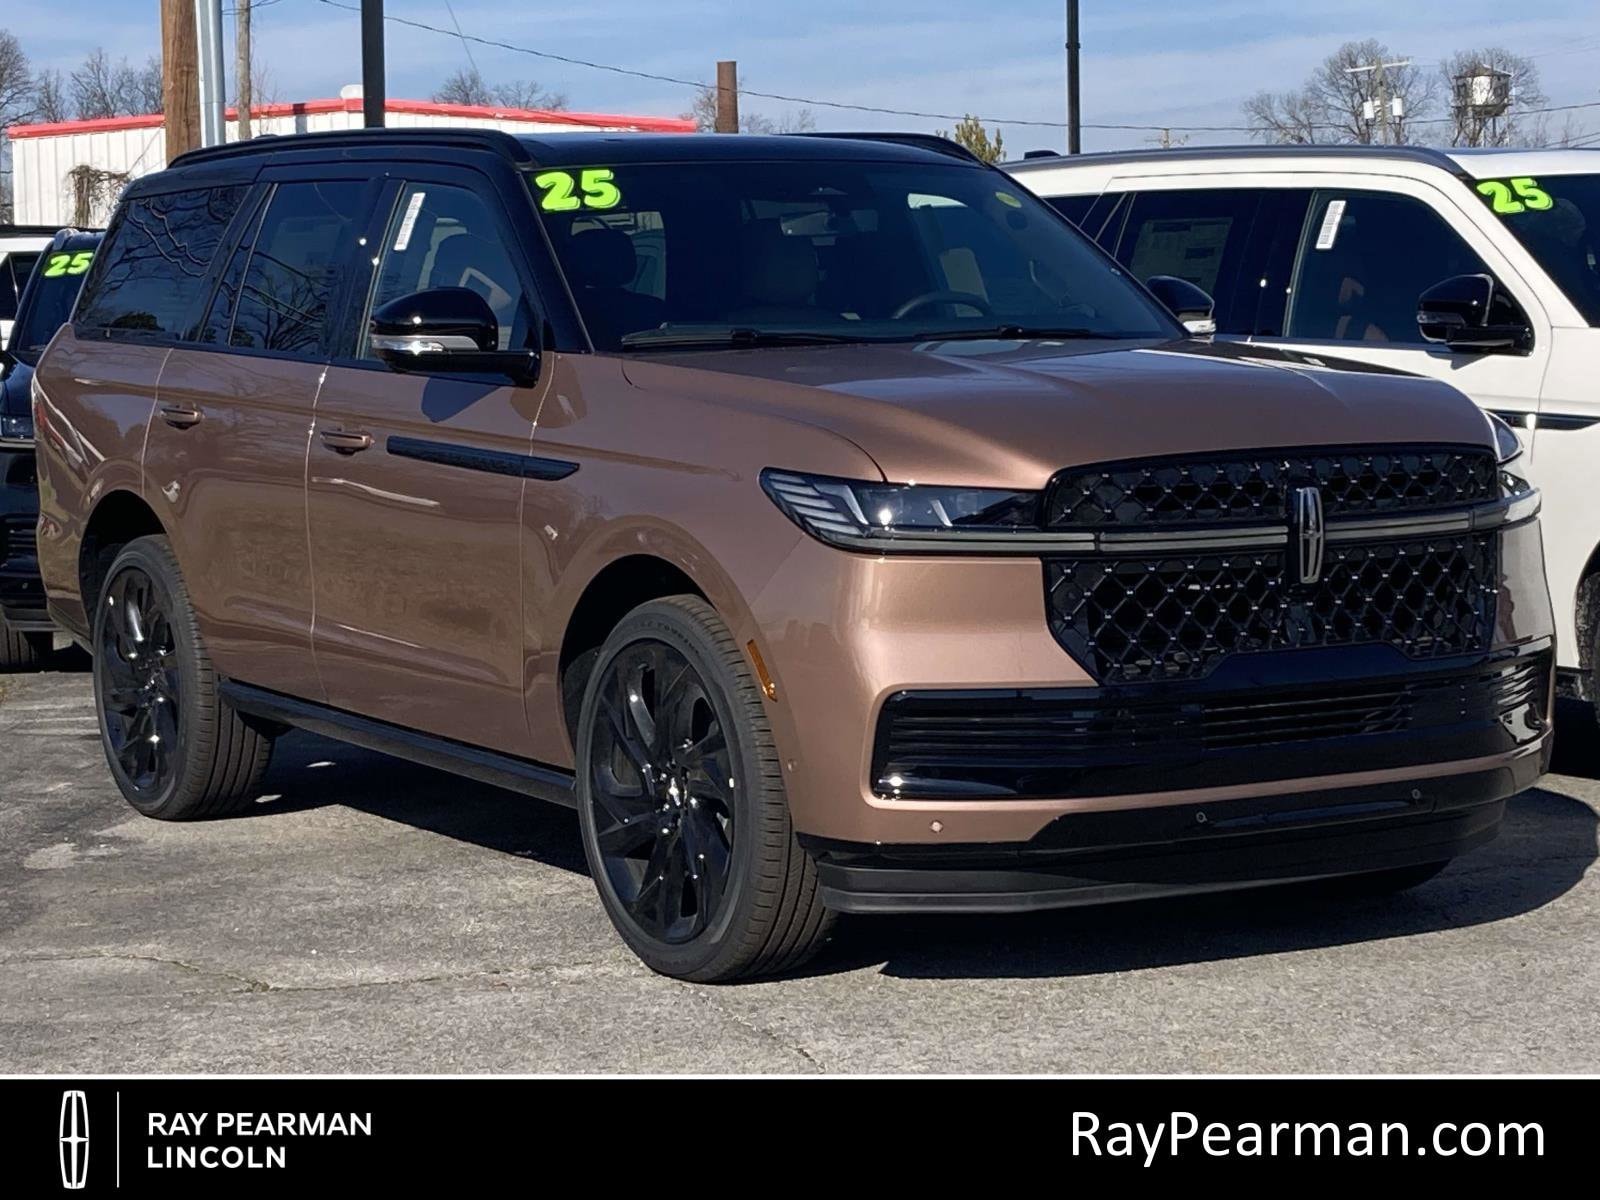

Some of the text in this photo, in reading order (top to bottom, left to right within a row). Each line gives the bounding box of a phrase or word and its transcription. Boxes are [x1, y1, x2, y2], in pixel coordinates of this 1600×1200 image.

[535, 169, 620, 211] 25
[1476, 178, 1553, 213] 25
[45, 252, 93, 277] 25
